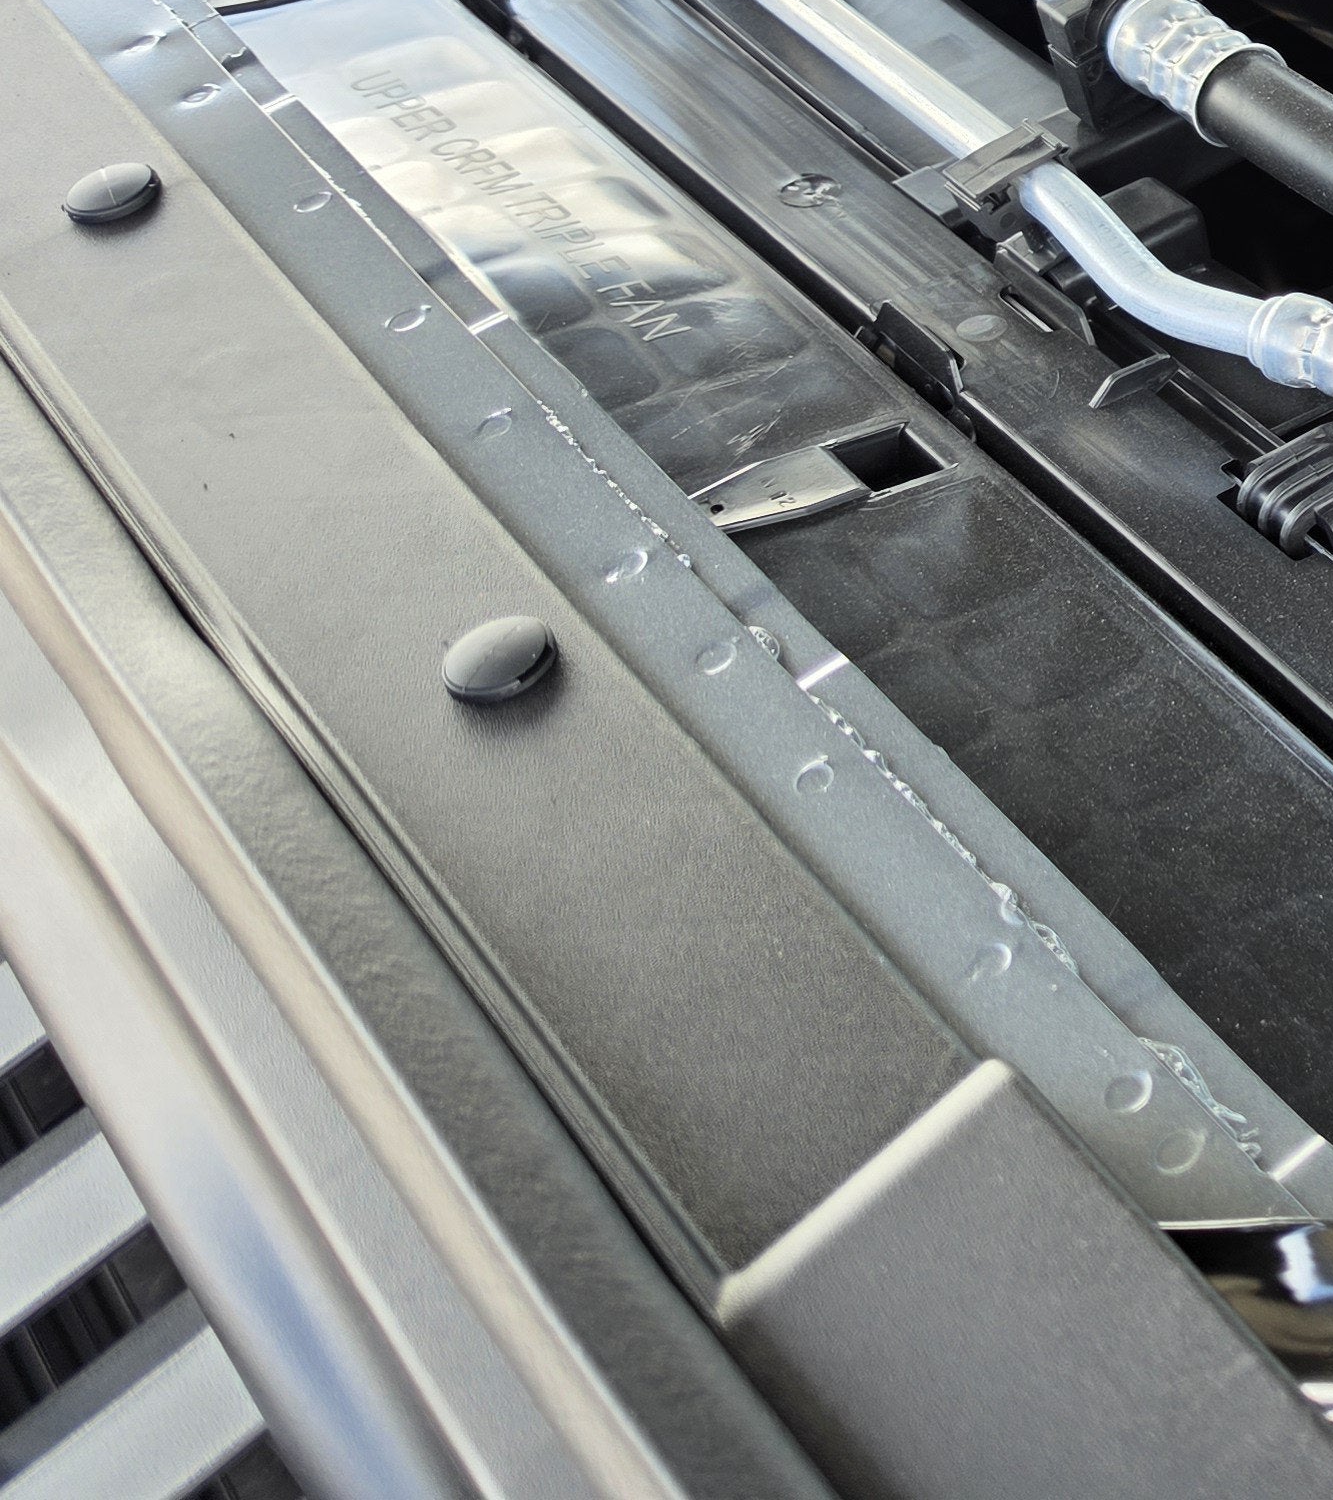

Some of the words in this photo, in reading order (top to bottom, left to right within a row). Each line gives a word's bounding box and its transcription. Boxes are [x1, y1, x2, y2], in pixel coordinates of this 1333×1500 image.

[351, 69, 457, 142] UPPER
[430, 137, 533, 197] CRFM
[499, 191, 632, 281] TRIPLE
[596, 279, 692, 342] FAN
